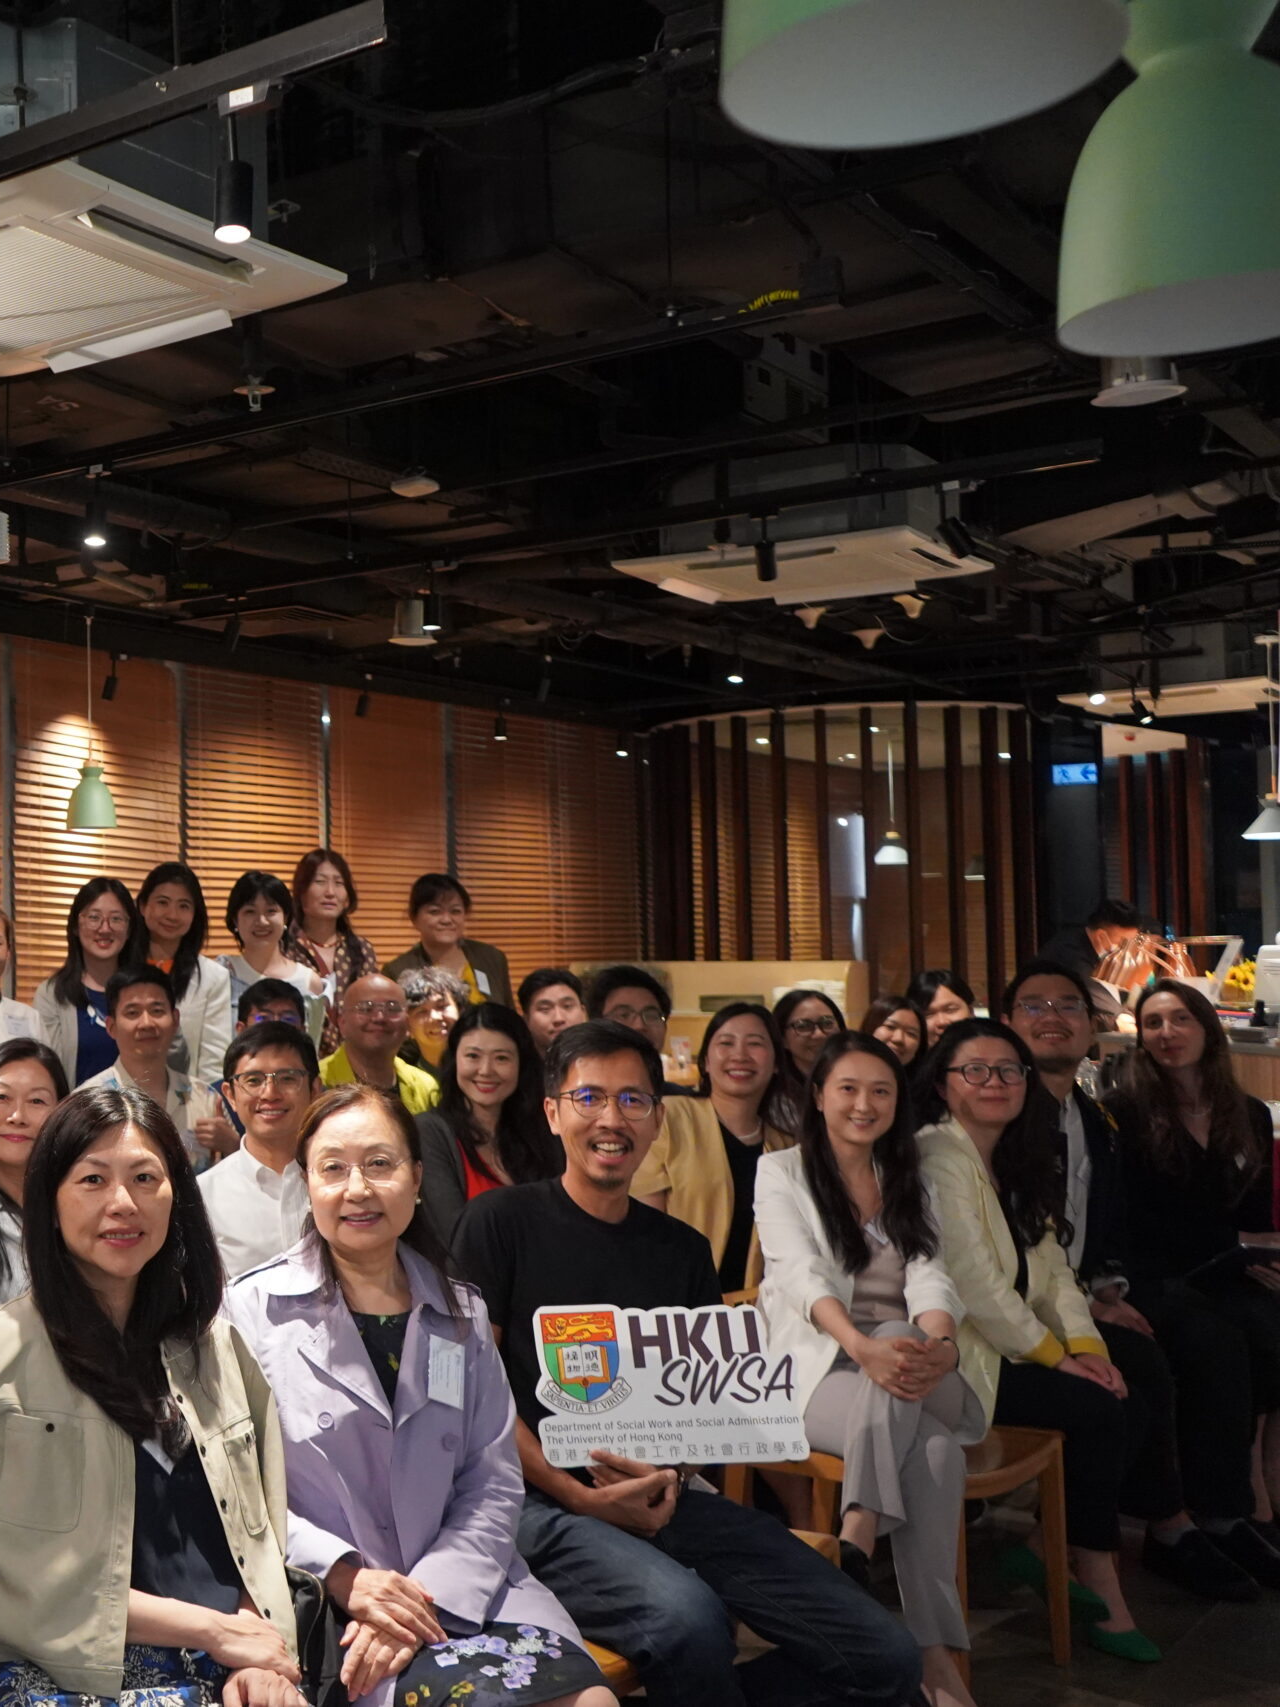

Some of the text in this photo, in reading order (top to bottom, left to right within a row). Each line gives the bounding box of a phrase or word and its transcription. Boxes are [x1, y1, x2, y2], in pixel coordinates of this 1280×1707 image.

[627, 1310, 761, 1369] HKU
[654, 1353, 794, 1406] SWSA
[544, 1389, 585, 1412] SAPIENTIA
[544, 1415, 800, 1433] Department of Social Work and Social Administration
[546, 1431, 683, 1445] The University of Hong Kong
